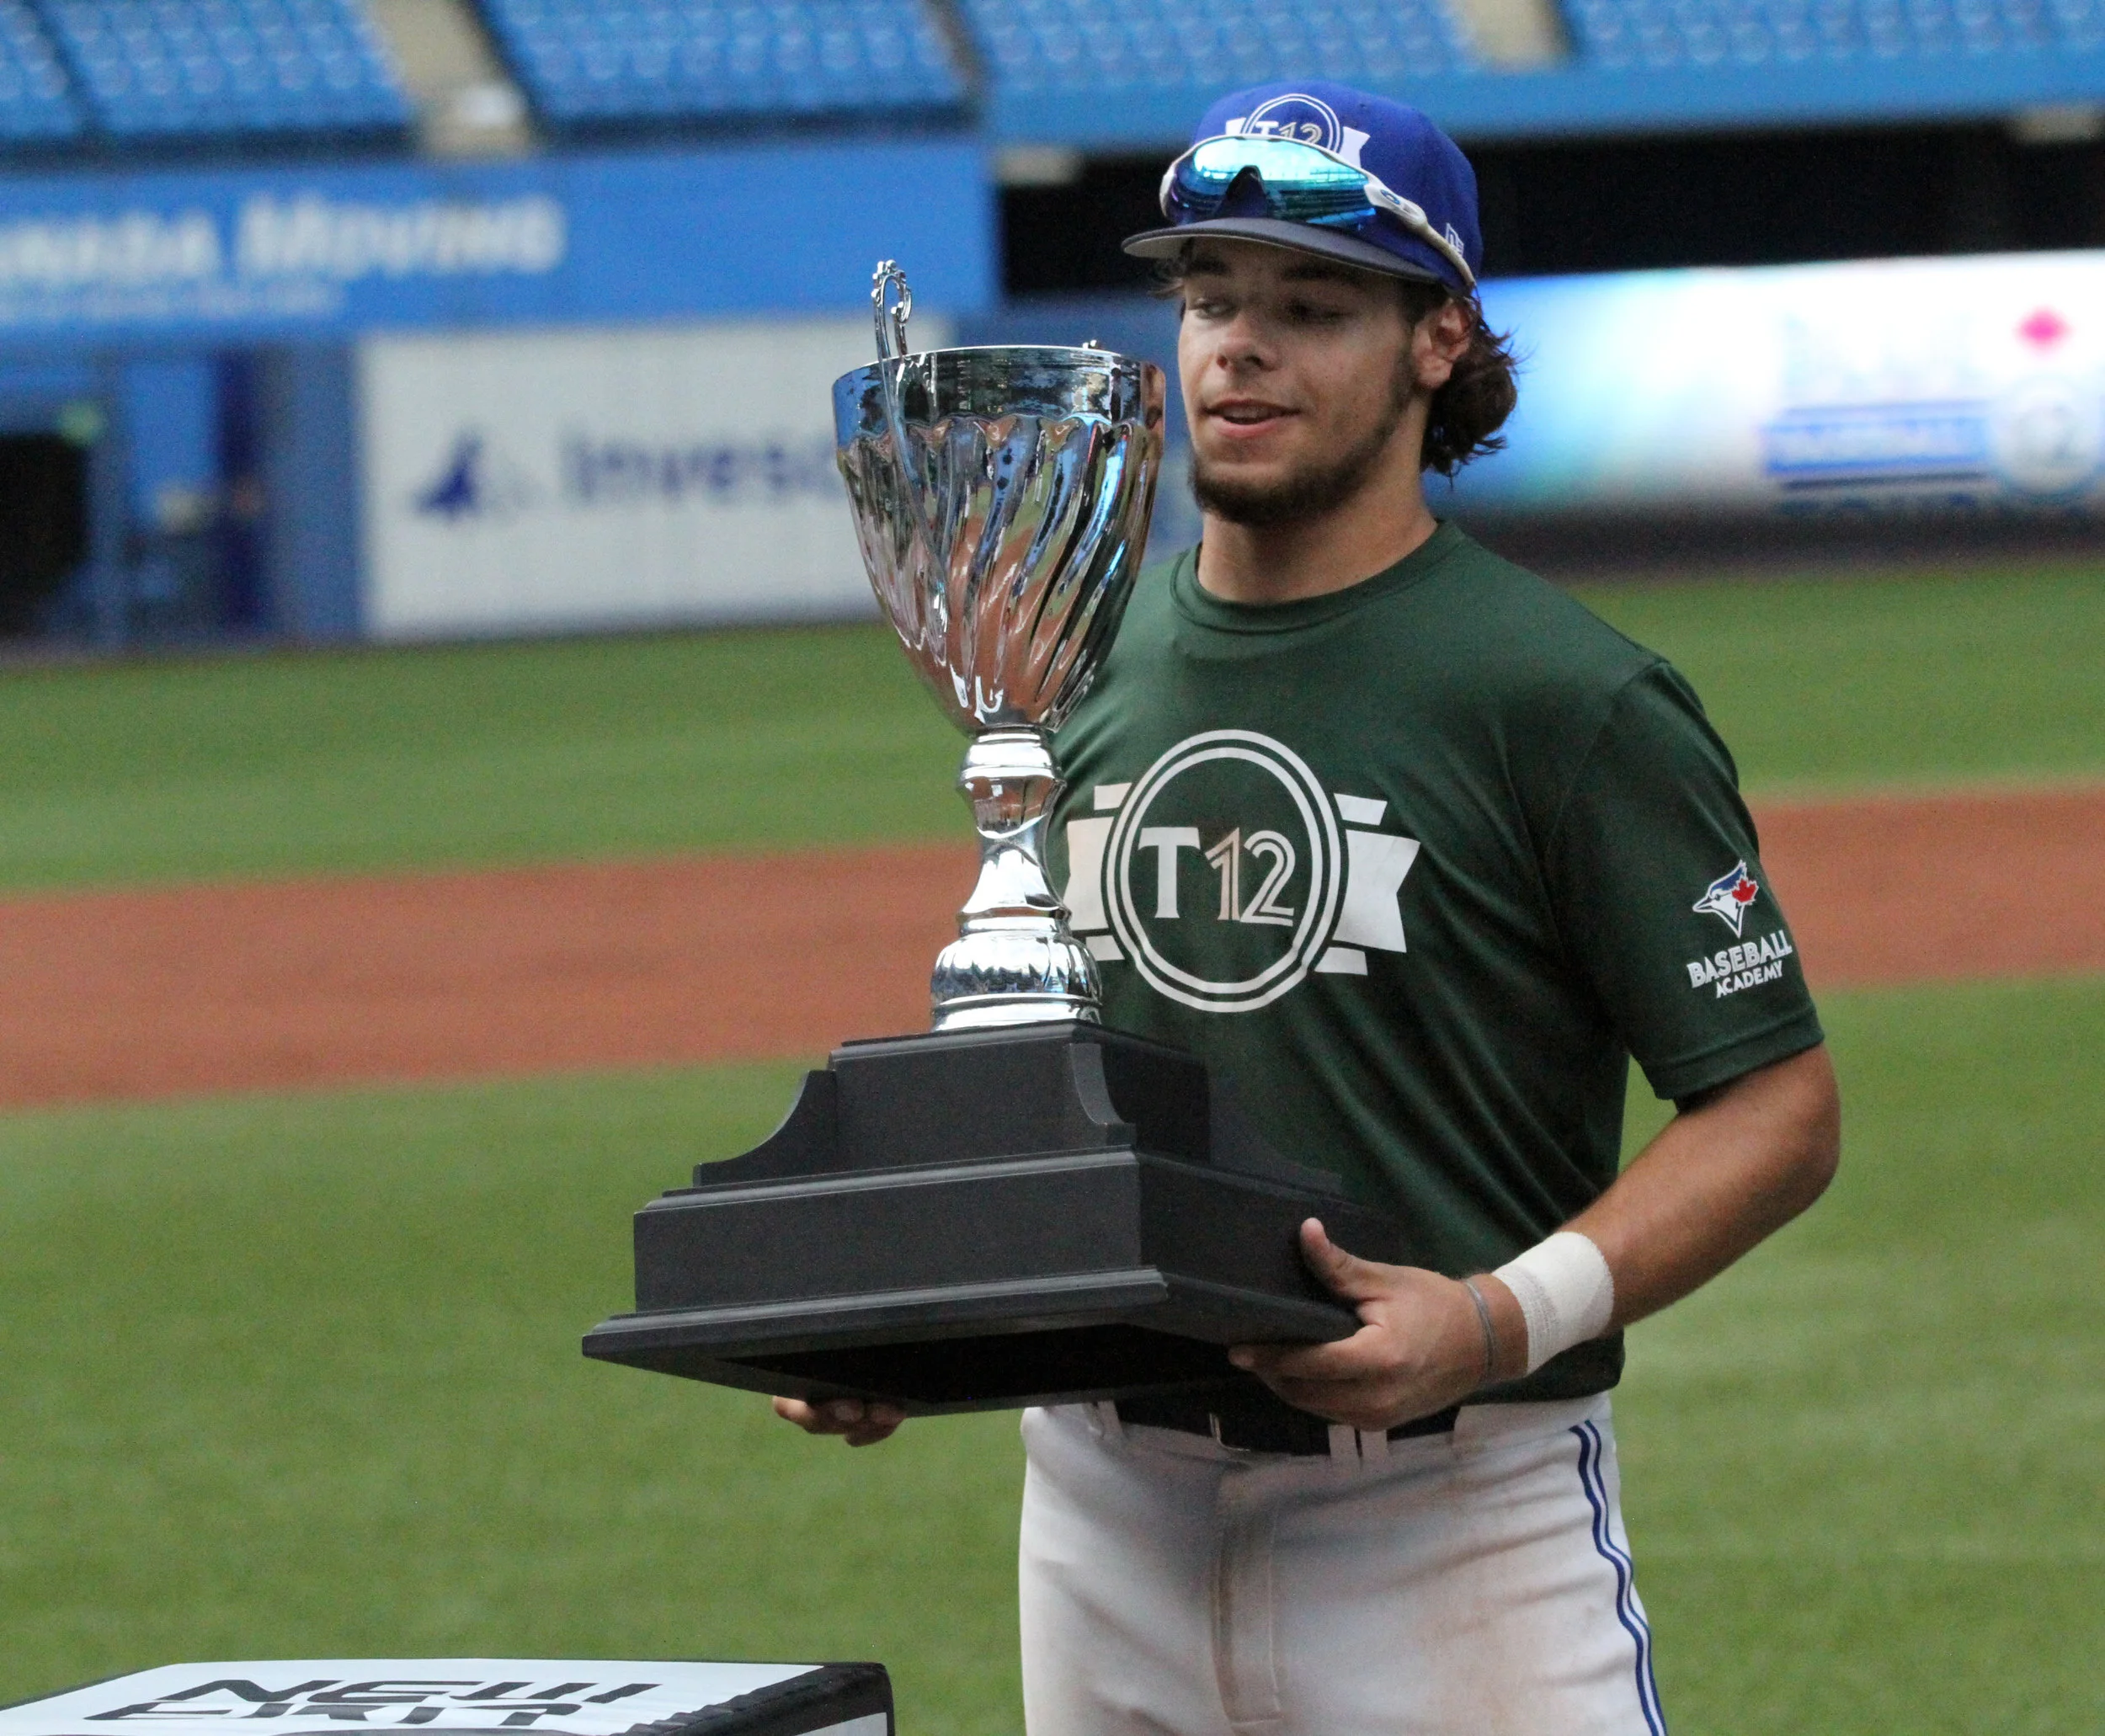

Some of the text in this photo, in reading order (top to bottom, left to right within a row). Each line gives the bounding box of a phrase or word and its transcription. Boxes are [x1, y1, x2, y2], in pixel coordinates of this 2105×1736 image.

[1138, 826, 1296, 927] T12
[1687, 929, 1793, 988] BASEBALL
[1716, 960, 1783, 998] ACADEMY
[155, 1679, 663, 1704] NEW
